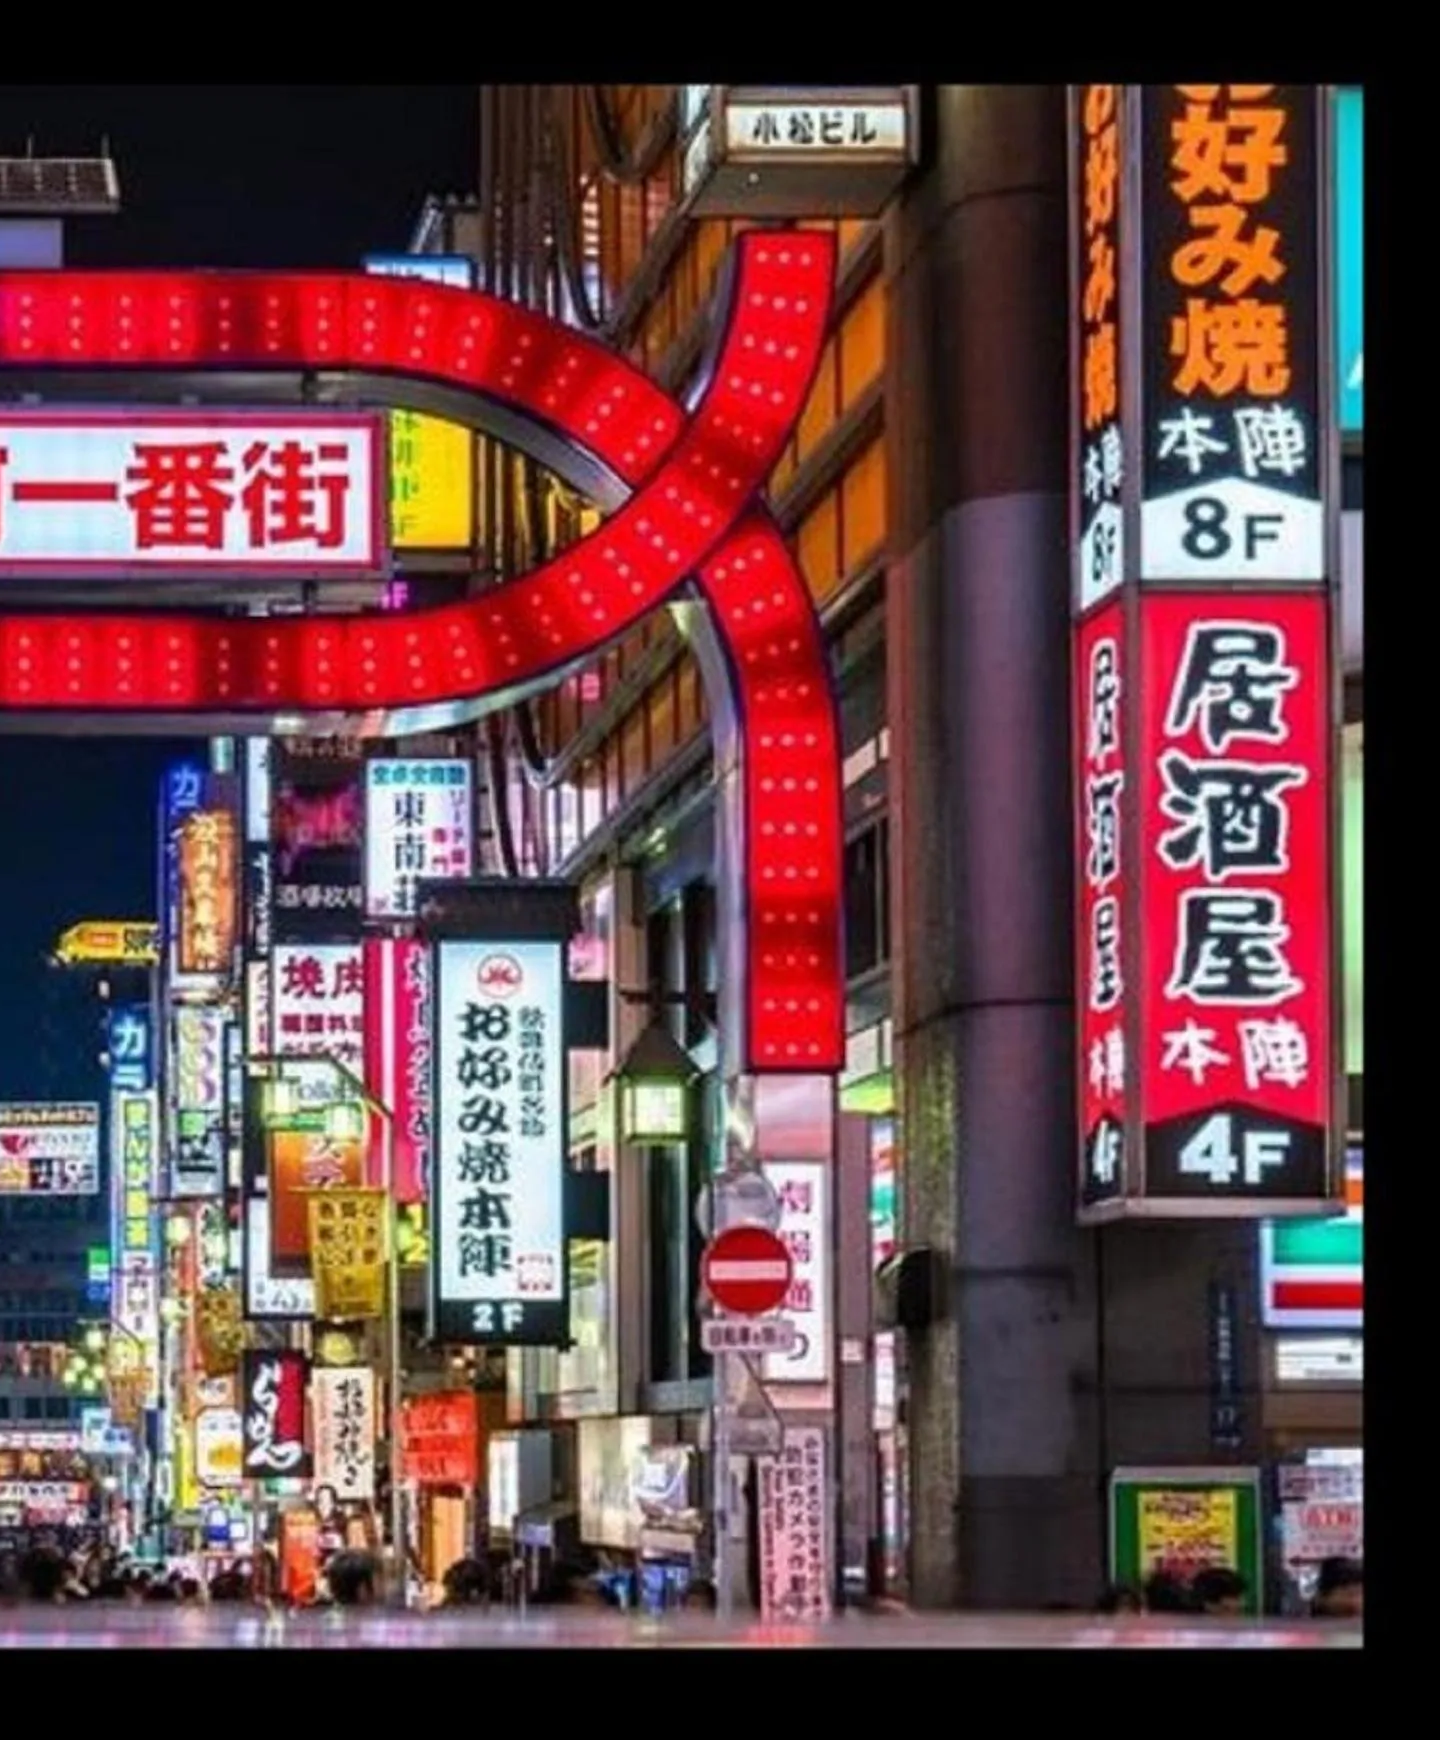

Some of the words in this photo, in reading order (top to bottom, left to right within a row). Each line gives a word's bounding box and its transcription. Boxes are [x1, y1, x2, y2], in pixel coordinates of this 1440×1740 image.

[753, 111, 876, 144] 小松ビル
[1170, 85, 1291, 395] 好み焼
[1159, 402, 1305, 477] 本陣
[1181, 496, 1283, 561] 8F
[1156, 620, 1308, 1008] 居酒屋
[1159, 1016, 1309, 1089] 本陣
[1178, 1113, 1293, 1184] 4F
[472, 1303, 524, 1333] 2F
